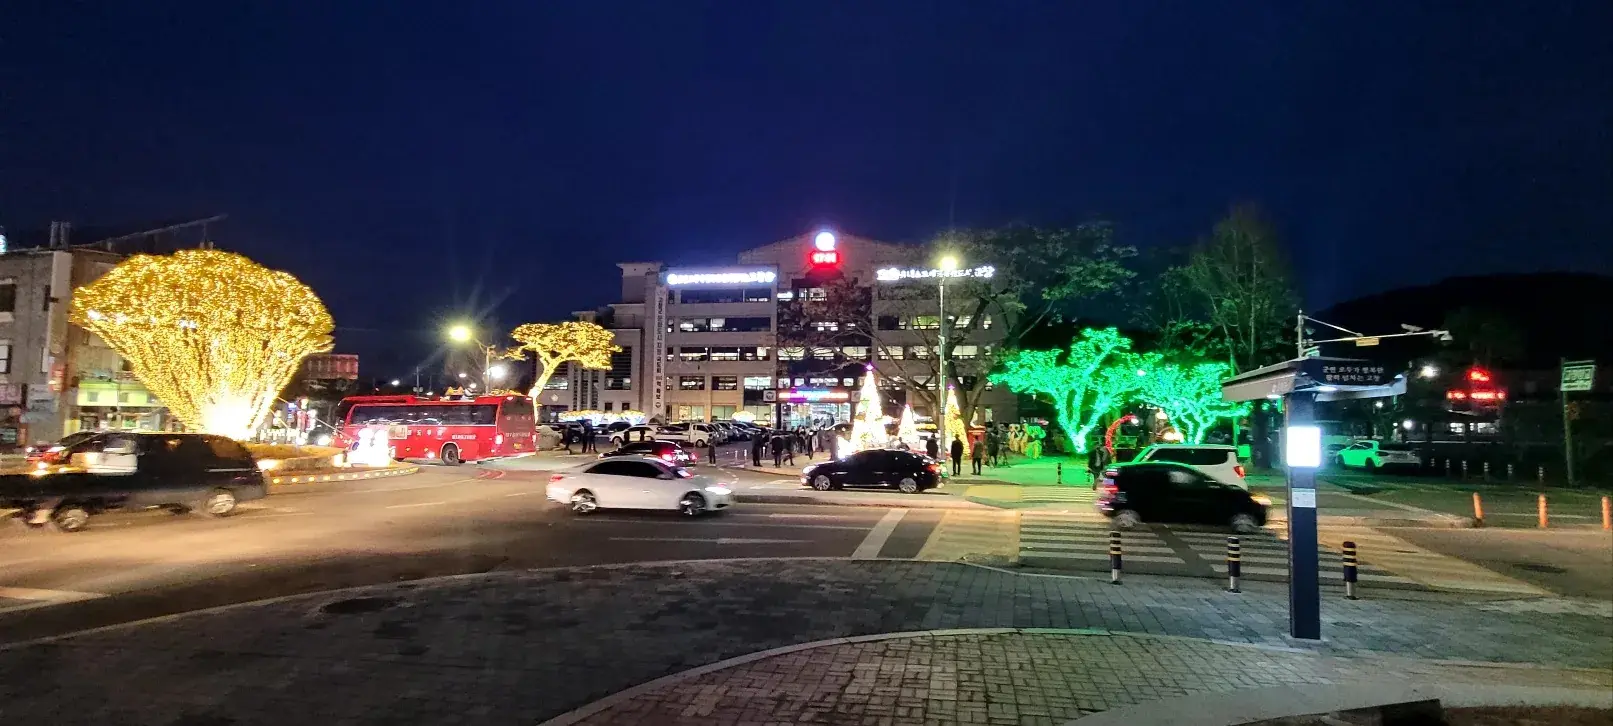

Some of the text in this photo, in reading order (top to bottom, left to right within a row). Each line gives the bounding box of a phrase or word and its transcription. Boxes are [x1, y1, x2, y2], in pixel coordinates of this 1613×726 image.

[1338, 366, 1360, 374] 모두가
[1362, 366, 1384, 374] 행복한
[1342, 374, 1365, 382] 넘치는
[1366, 374, 1381, 382] 고창
